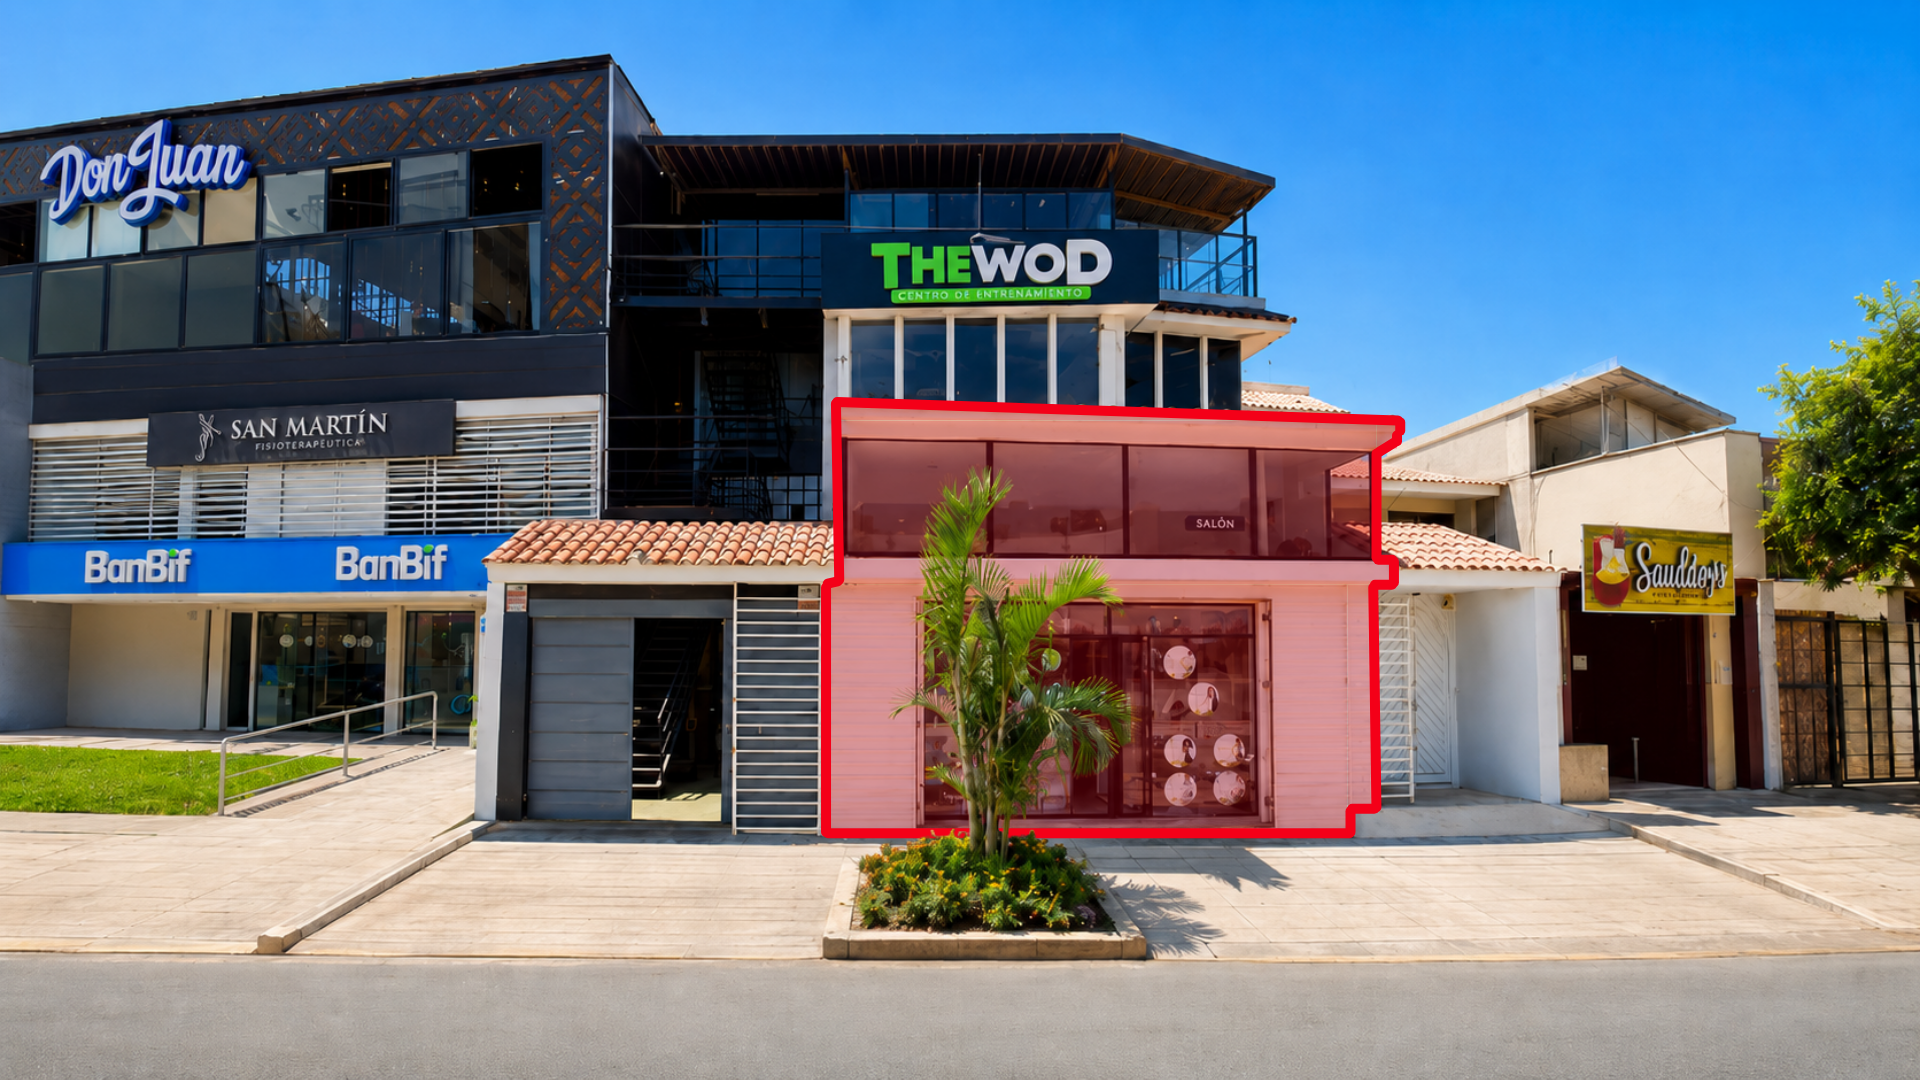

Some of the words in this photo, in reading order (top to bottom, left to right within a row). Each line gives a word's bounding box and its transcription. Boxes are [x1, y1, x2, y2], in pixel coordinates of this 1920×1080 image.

[40, 144, 132, 222] Don
[118, 118, 249, 224] Juan
[897, 290, 949, 301] CENTRO
[976, 287, 1083, 299] ENTRENAMIENTO
[231, 418, 277, 440] SAN
[285, 408, 388, 437] MARTÍN
[1196, 516, 1235, 529] SALÓN
[84, 549, 192, 583] BanBif
[336, 544, 448, 581] BanBif
